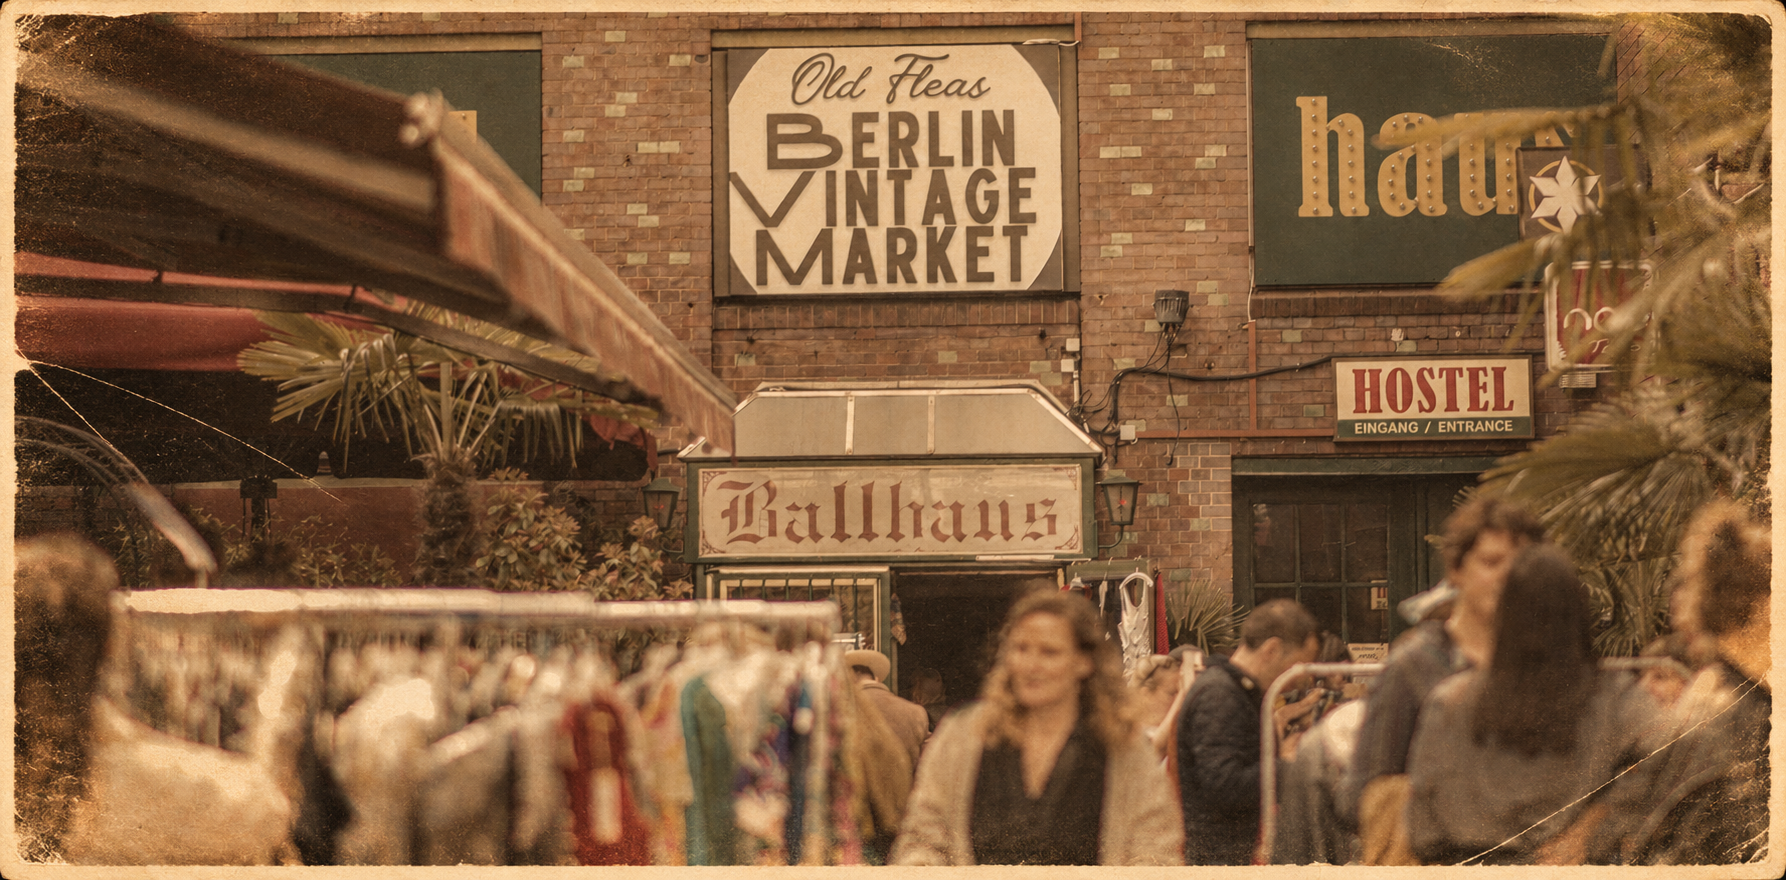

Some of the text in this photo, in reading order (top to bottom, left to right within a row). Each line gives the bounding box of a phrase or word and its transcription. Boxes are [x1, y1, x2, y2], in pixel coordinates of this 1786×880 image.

[791, 52, 991, 105] Old Fleas
[766, 109, 1015, 170] BERLIN
[1296, 96, 1576, 217] hau
[729, 167, 1037, 228] VINTAGE
[755, 225, 1028, 286] MARKET
[1352, 366, 1514, 414] HOSTEL
[1354, 421, 1419, 434] EINGANG
[1438, 419, 1513, 433] ENTRANCE
[716, 479, 1057, 545] Ballhaus
